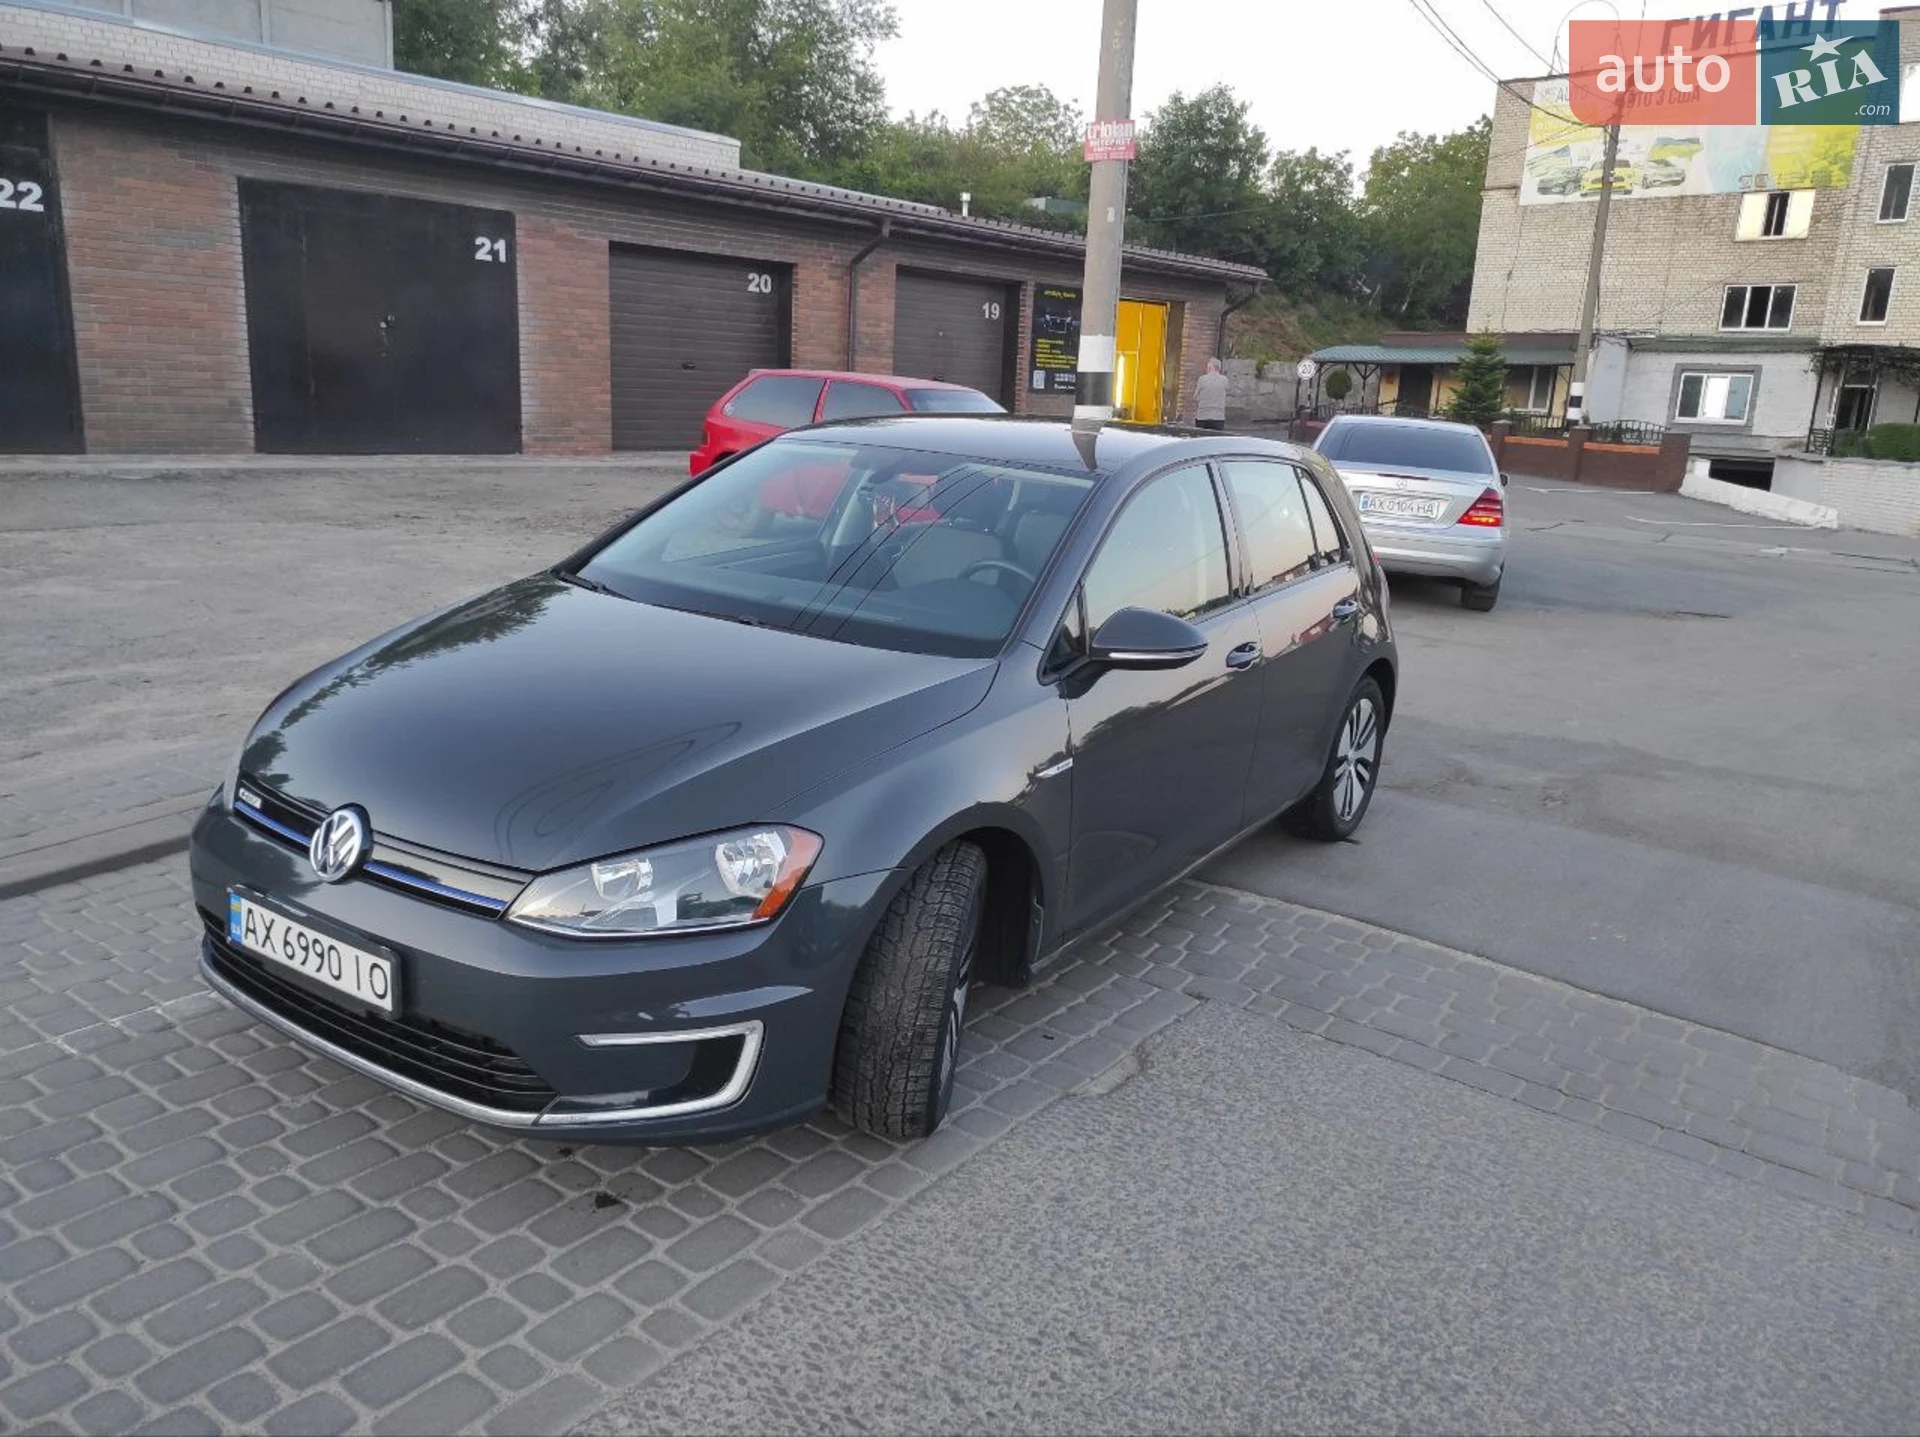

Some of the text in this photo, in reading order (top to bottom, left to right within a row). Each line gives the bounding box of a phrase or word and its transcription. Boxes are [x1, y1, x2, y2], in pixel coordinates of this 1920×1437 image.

[1660, 0, 1847, 55] ГИГАНТ
[0, 178, 44, 212] 22
[475, 236, 506, 263] 21
[747, 272, 772, 294] 20
[982, 301, 1000, 320] 19
[1369, 499, 1434, 516] AX 0104 HA
[244, 907, 388, 1000] AX 6990 IO
